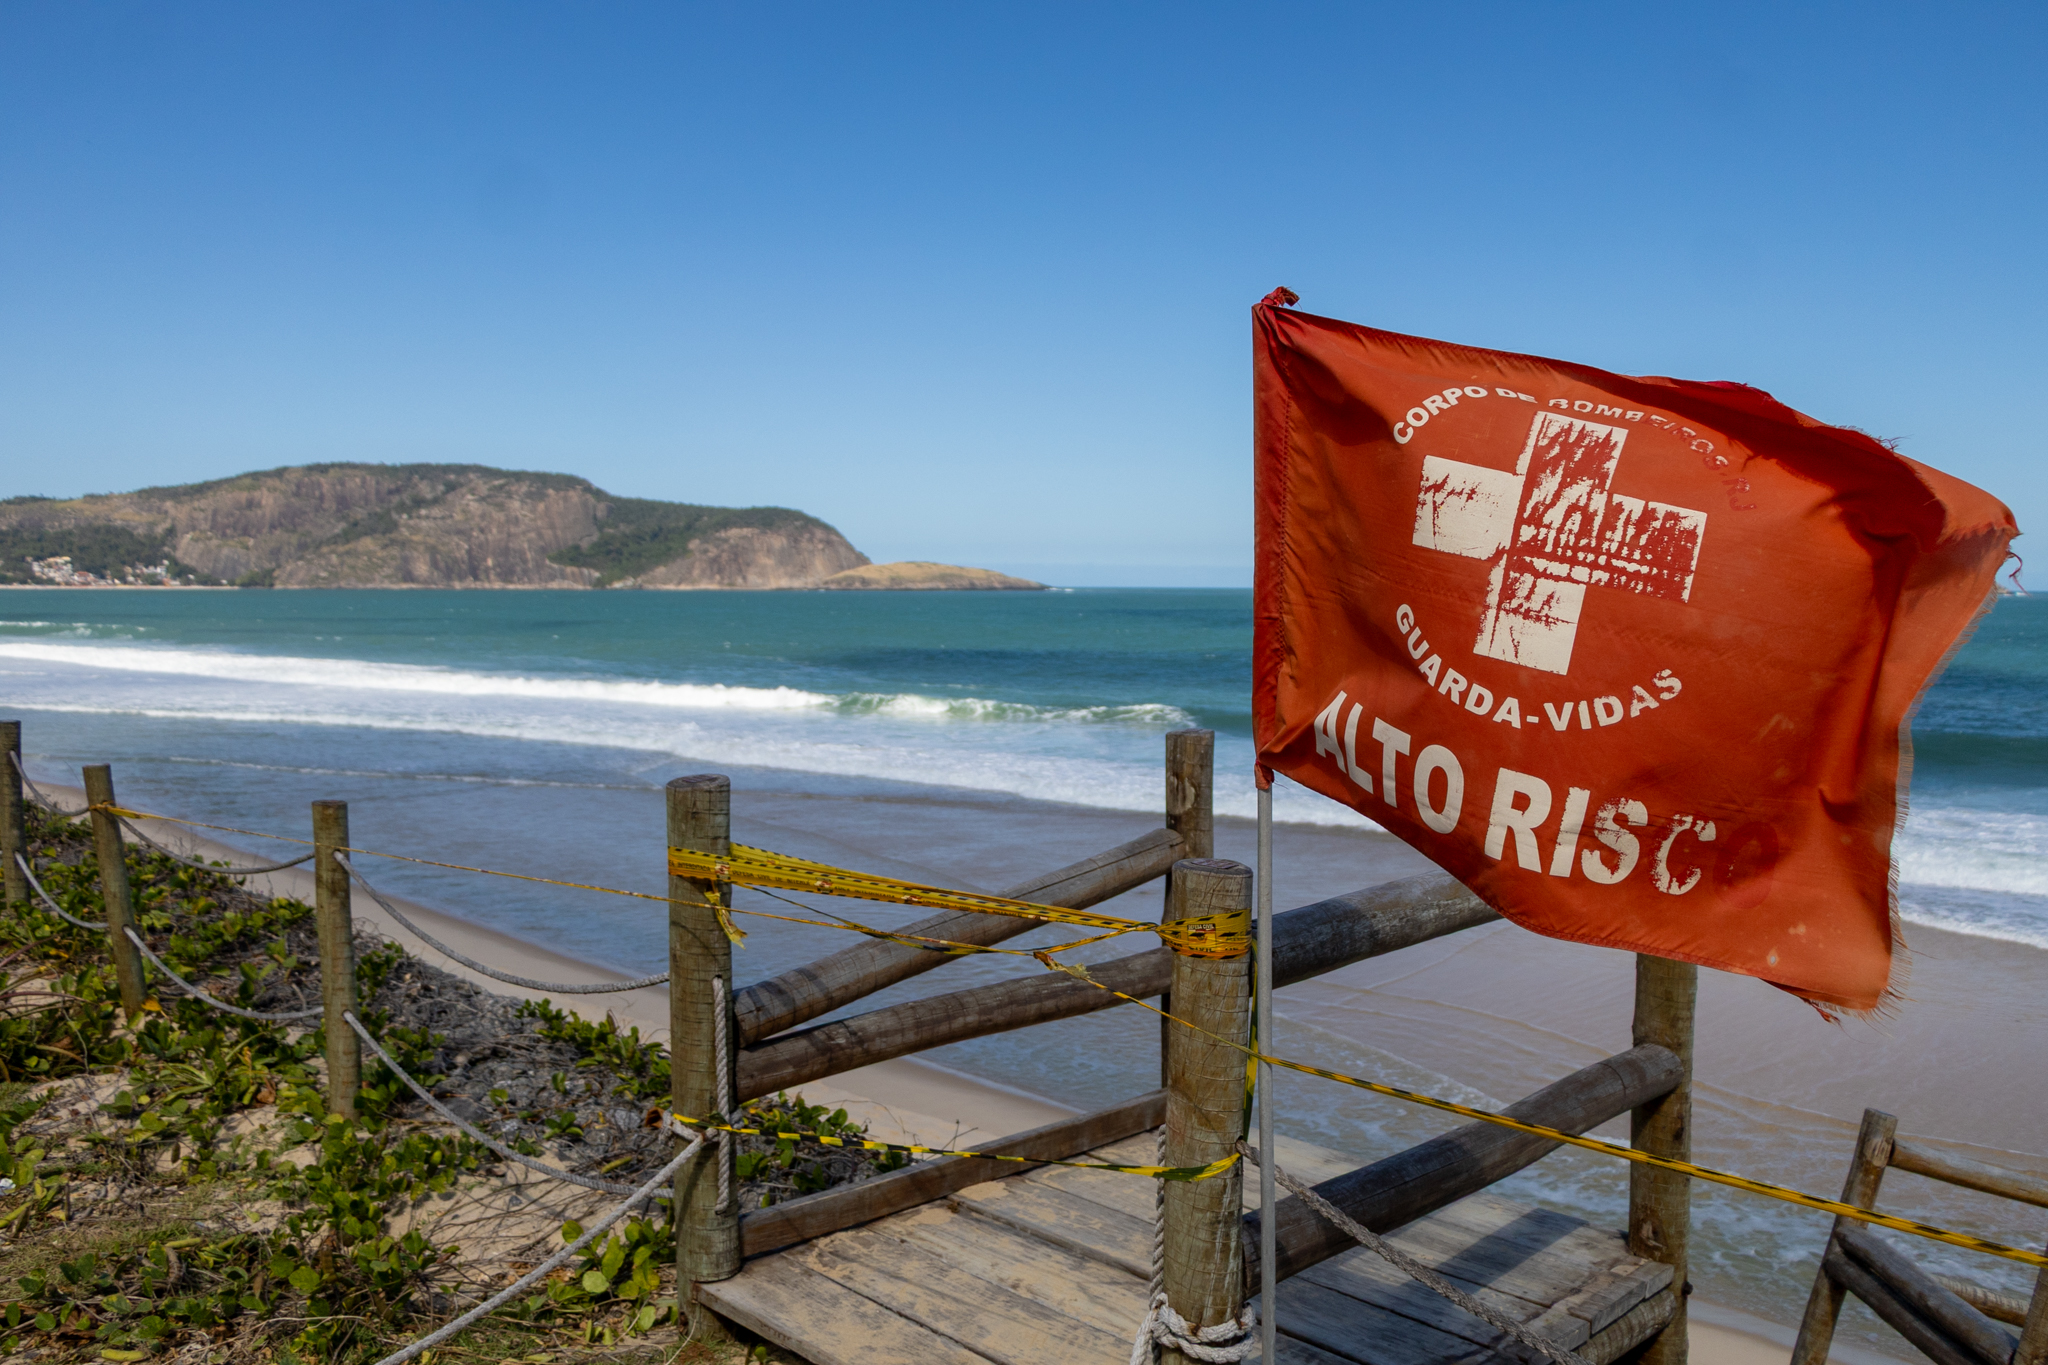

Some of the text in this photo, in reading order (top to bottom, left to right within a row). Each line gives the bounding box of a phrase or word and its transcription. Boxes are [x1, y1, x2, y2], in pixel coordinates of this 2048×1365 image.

[1393, 385, 1489, 445] CORPO
[1495, 386, 1540, 404] DE
[1395, 603, 1683, 732] GUARDA-VIDAS
[1313, 690, 1466, 835] ALTO
